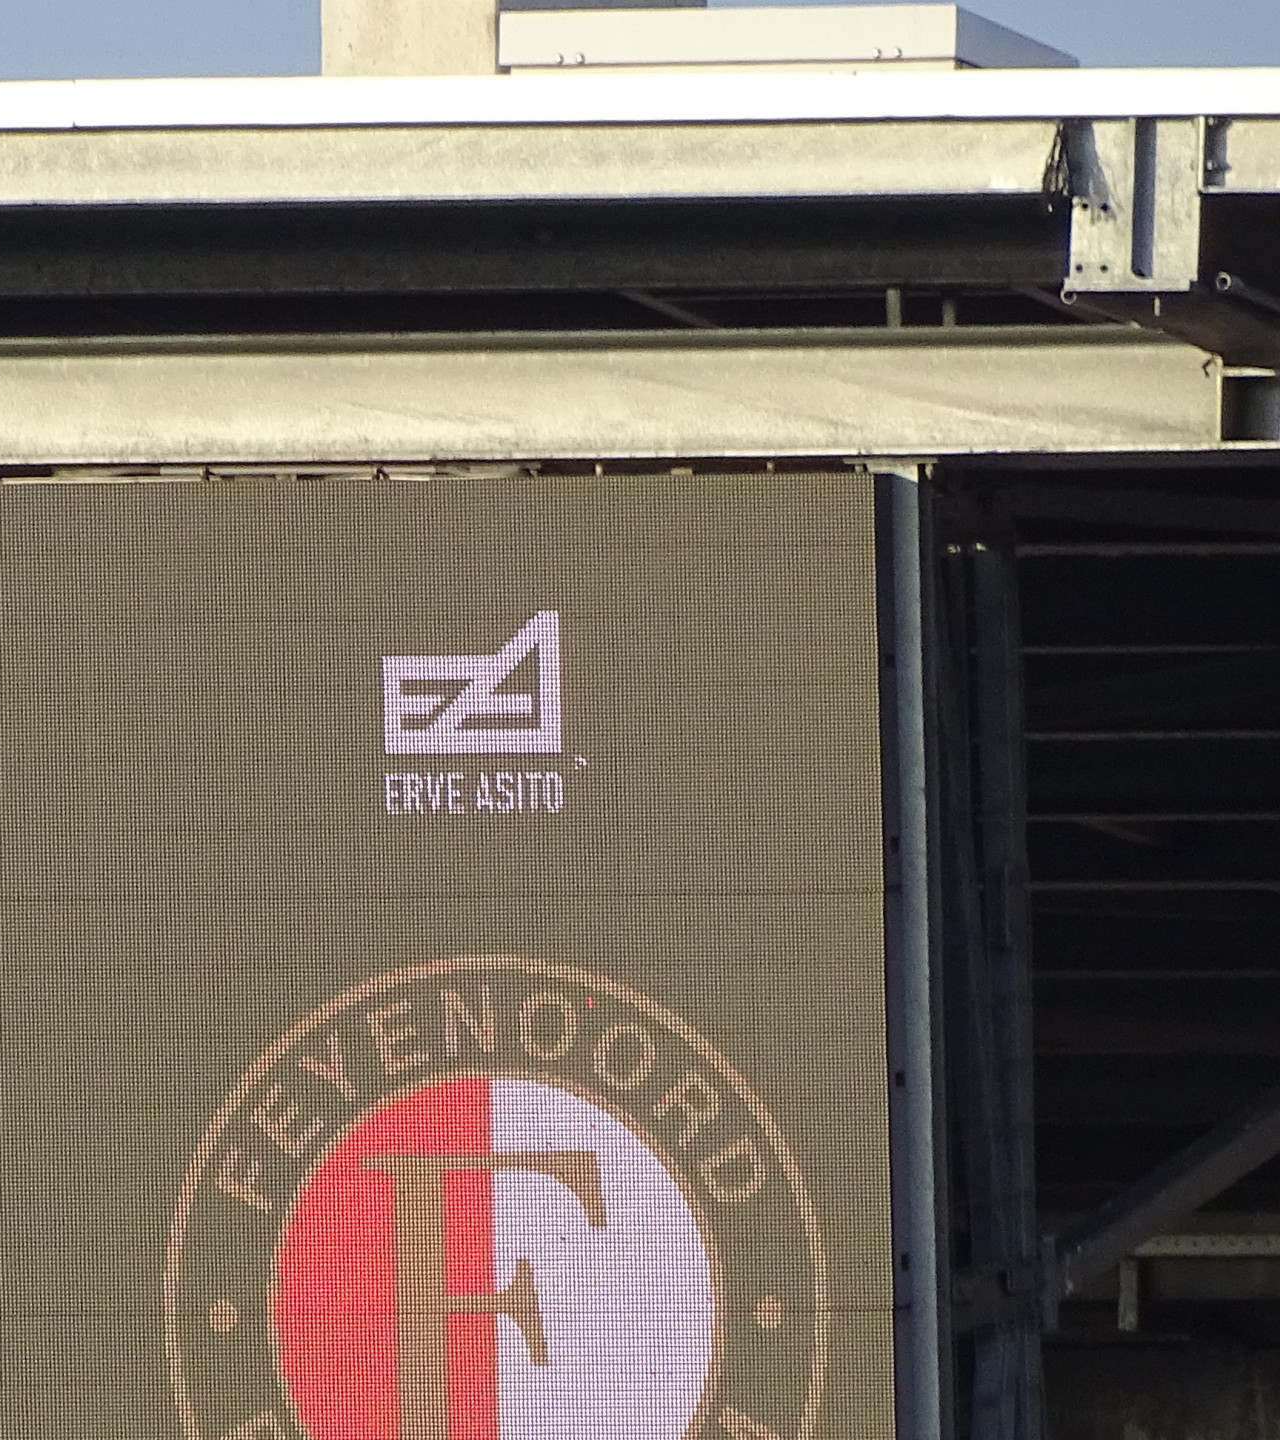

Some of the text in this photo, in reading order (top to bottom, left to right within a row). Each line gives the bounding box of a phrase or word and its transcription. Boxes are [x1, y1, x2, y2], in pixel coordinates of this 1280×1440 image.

[384, 770, 564, 815] ERVE ASITO
[217, 985, 770, 1212] FEYENOORD
